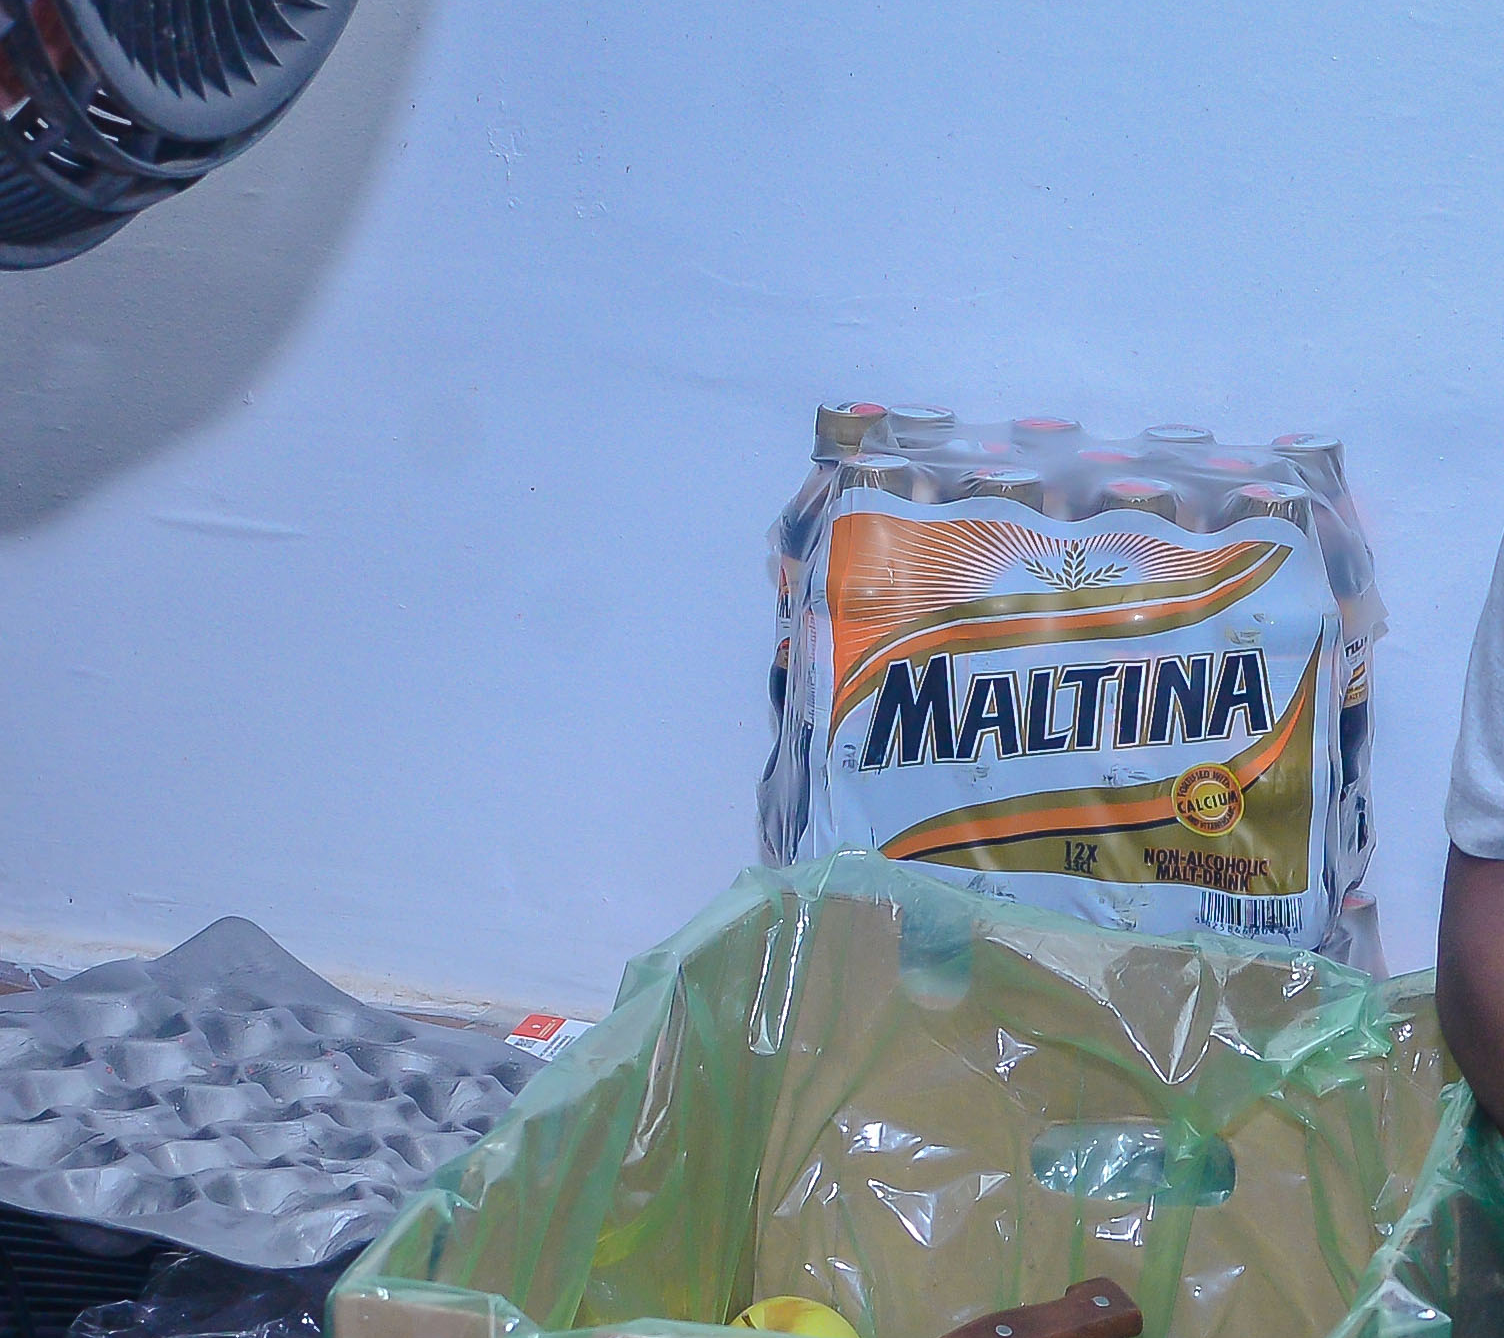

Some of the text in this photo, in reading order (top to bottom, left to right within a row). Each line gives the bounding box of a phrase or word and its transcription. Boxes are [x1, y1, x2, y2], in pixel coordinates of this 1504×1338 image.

[858, 649, 1276, 773] MALTINA
[1177, 790, 1238, 813] CALCIUM
[1063, 840, 1098, 863] 12X
[1144, 847, 1271, 877] NON-ALCOHOLIC
[1156, 863, 1250, 892] MALT-DRINK
